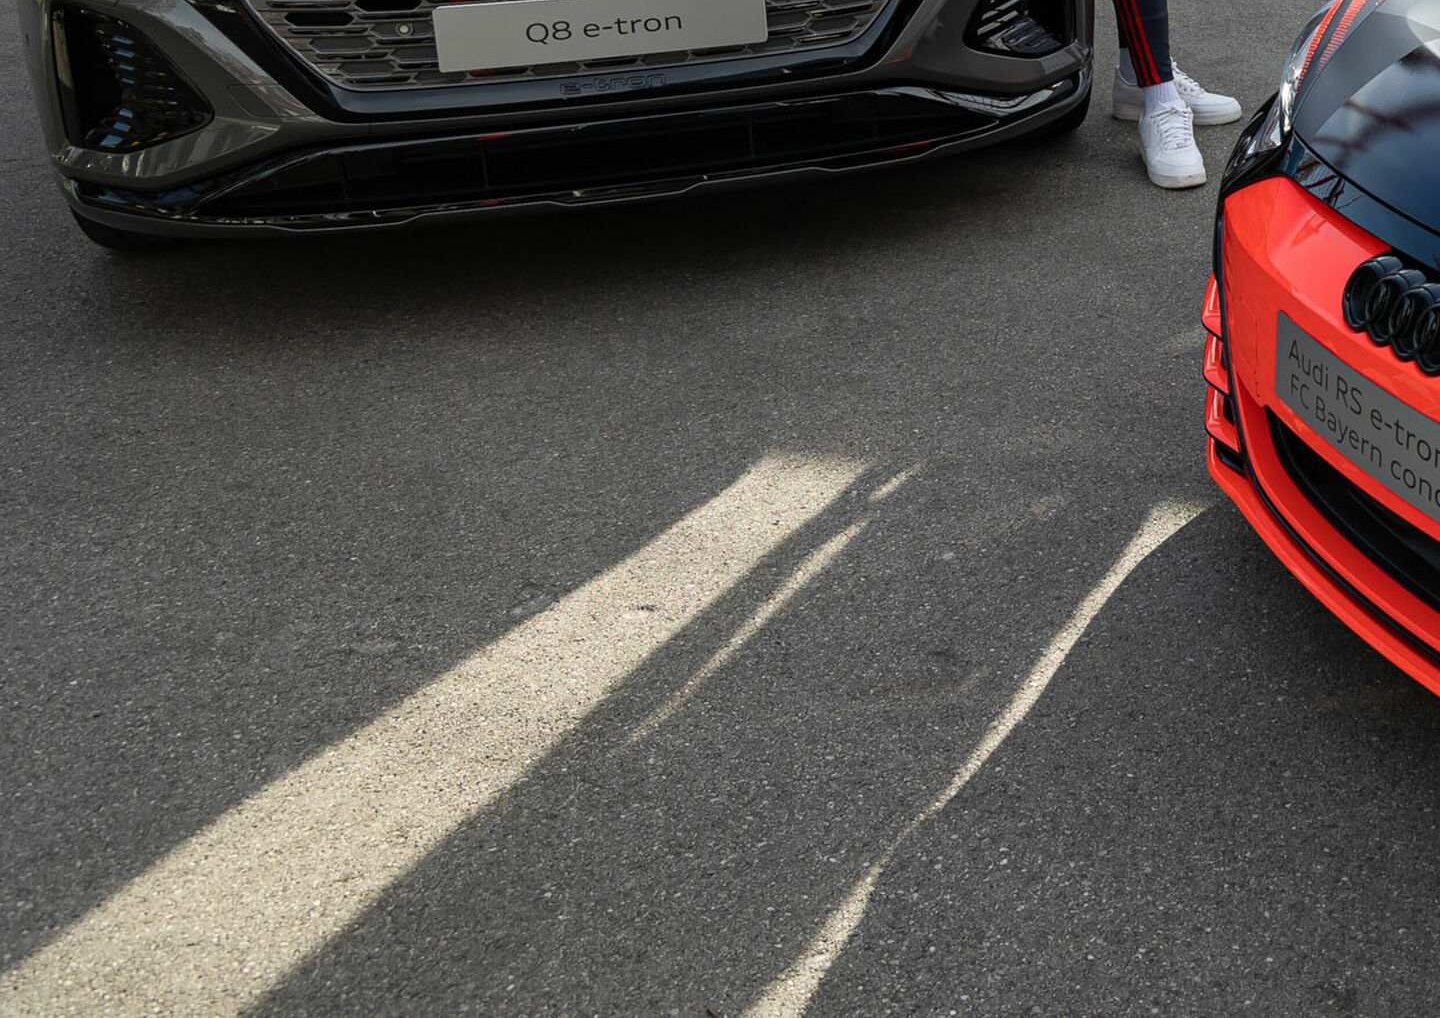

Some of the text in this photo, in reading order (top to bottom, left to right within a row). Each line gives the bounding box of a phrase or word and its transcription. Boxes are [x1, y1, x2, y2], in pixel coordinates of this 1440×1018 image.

[526, 14, 682, 45] Q8 e-tron
[1288, 340, 1329, 391] Audi
[1336, 375, 1363, 415] RS
[1291, 373, 1310, 410] FC
[1315, 395, 1382, 468] Bayern
